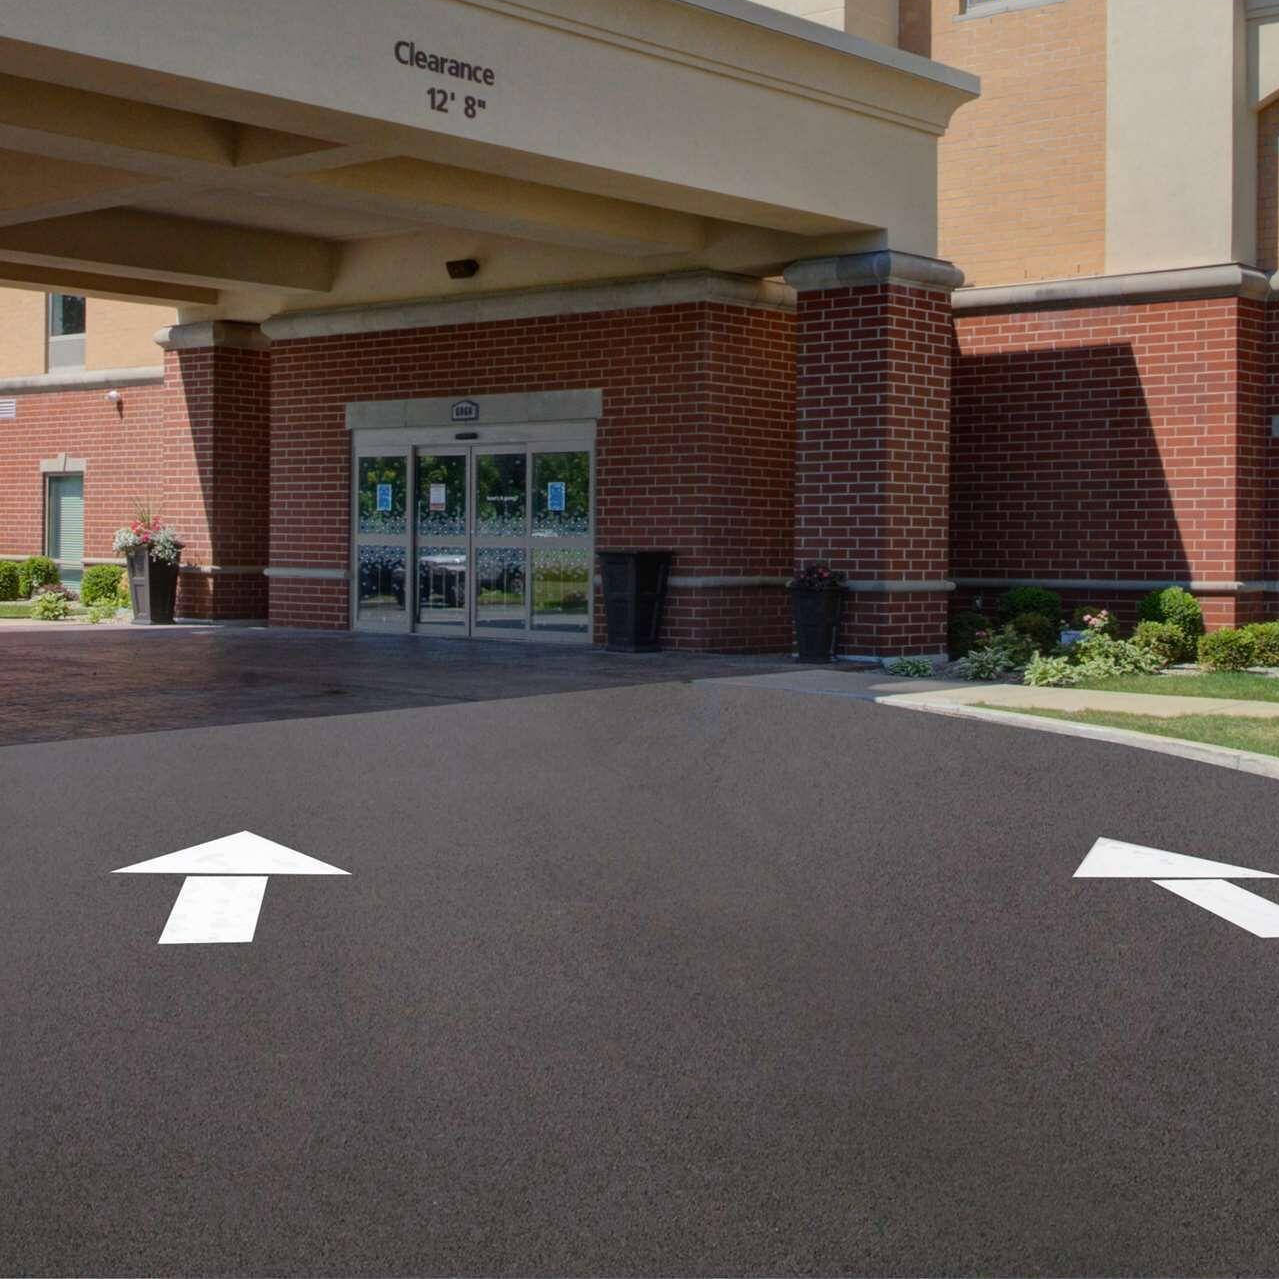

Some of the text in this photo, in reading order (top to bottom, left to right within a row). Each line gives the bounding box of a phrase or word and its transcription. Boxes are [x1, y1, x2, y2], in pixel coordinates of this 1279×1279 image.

[393, 40, 496, 86] Clearance
[426, 87, 487, 119] 12' 8"
